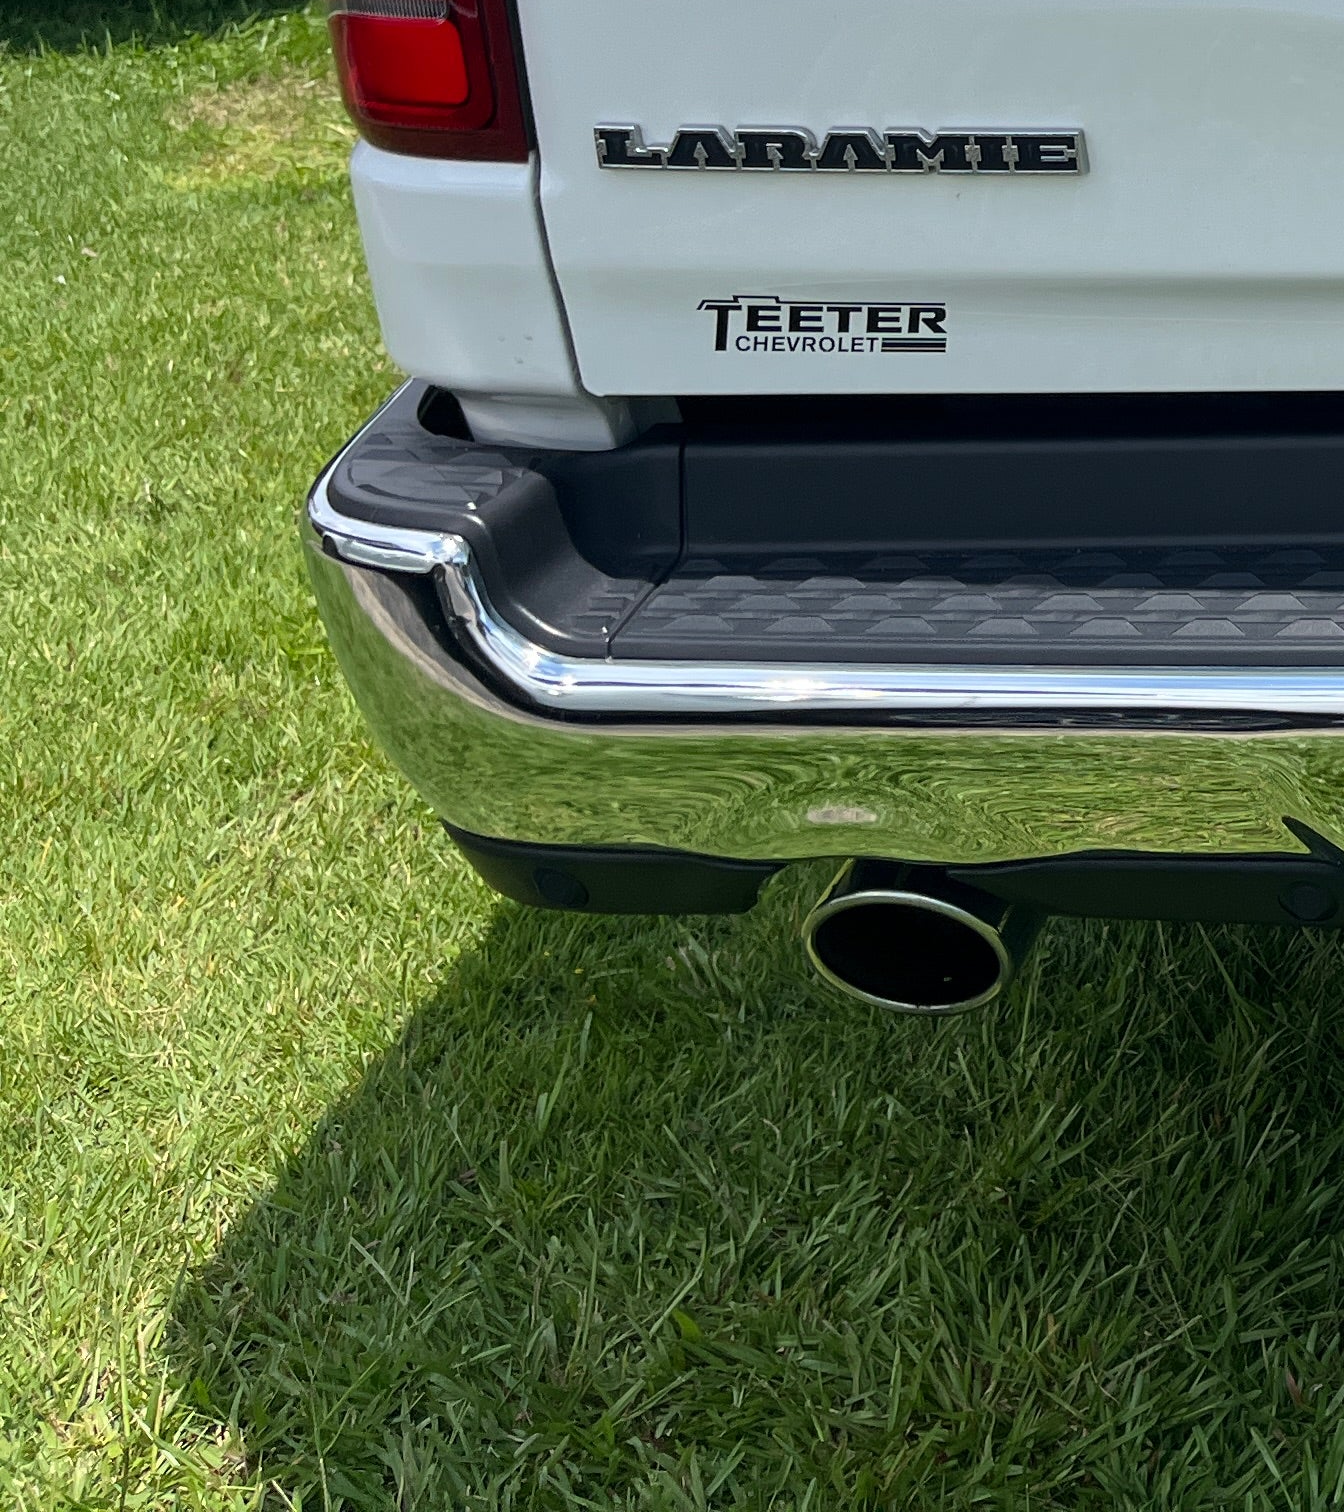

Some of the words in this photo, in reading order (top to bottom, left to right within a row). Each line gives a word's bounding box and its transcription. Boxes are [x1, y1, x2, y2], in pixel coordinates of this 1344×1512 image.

[594, 122, 1090, 175] LARAMIE
[702, 303, 948, 352] TEETER
[735, 336, 879, 353] CHEVROLET
